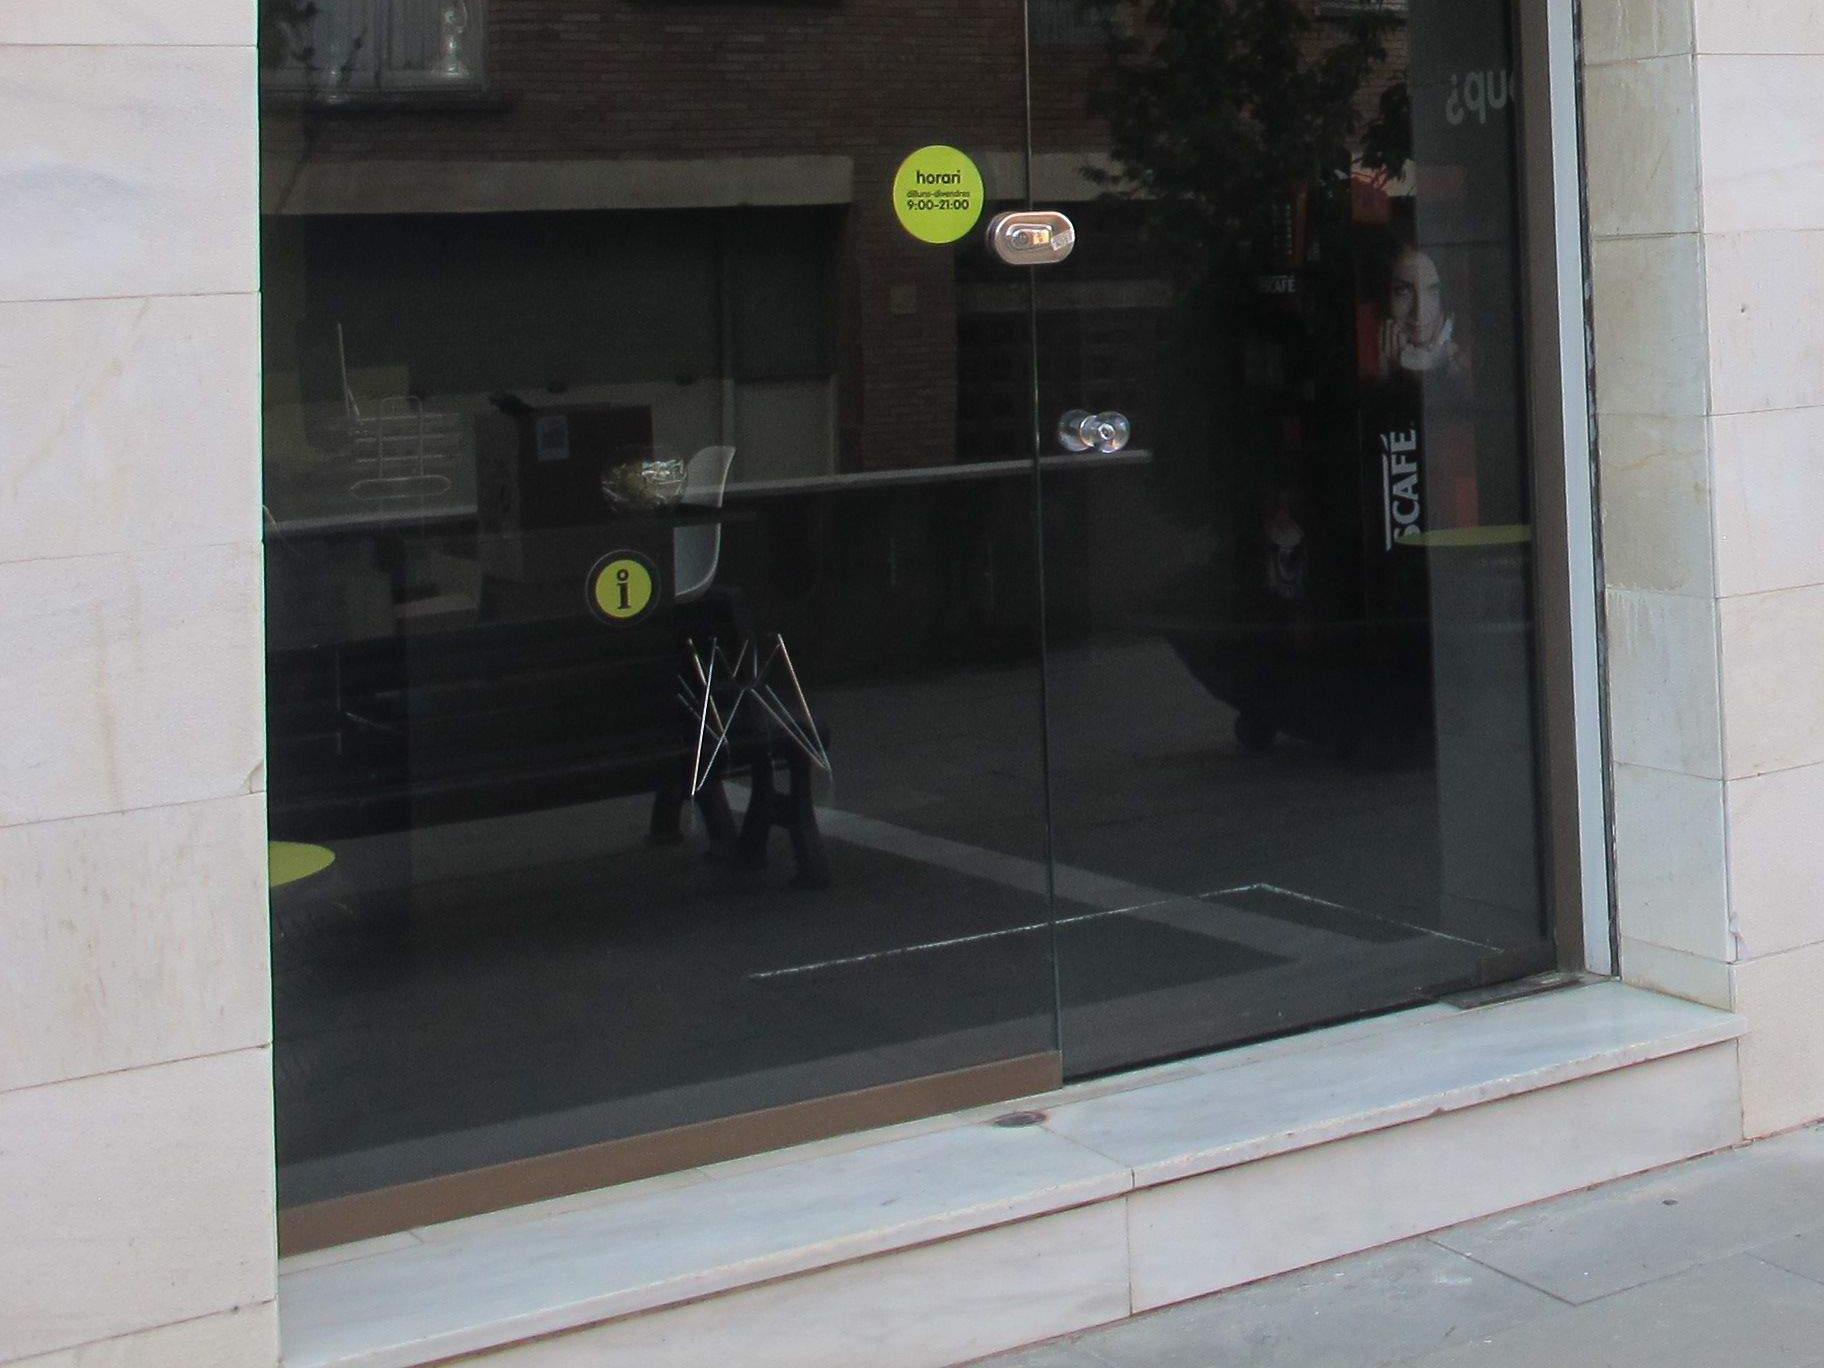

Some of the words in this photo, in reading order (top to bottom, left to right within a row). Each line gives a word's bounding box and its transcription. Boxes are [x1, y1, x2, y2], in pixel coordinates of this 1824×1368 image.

[1445, 70, 1518, 125] ¿qu
[916, 170, 961, 185] horari
[906, 199, 970, 210] 9:00-21:00
